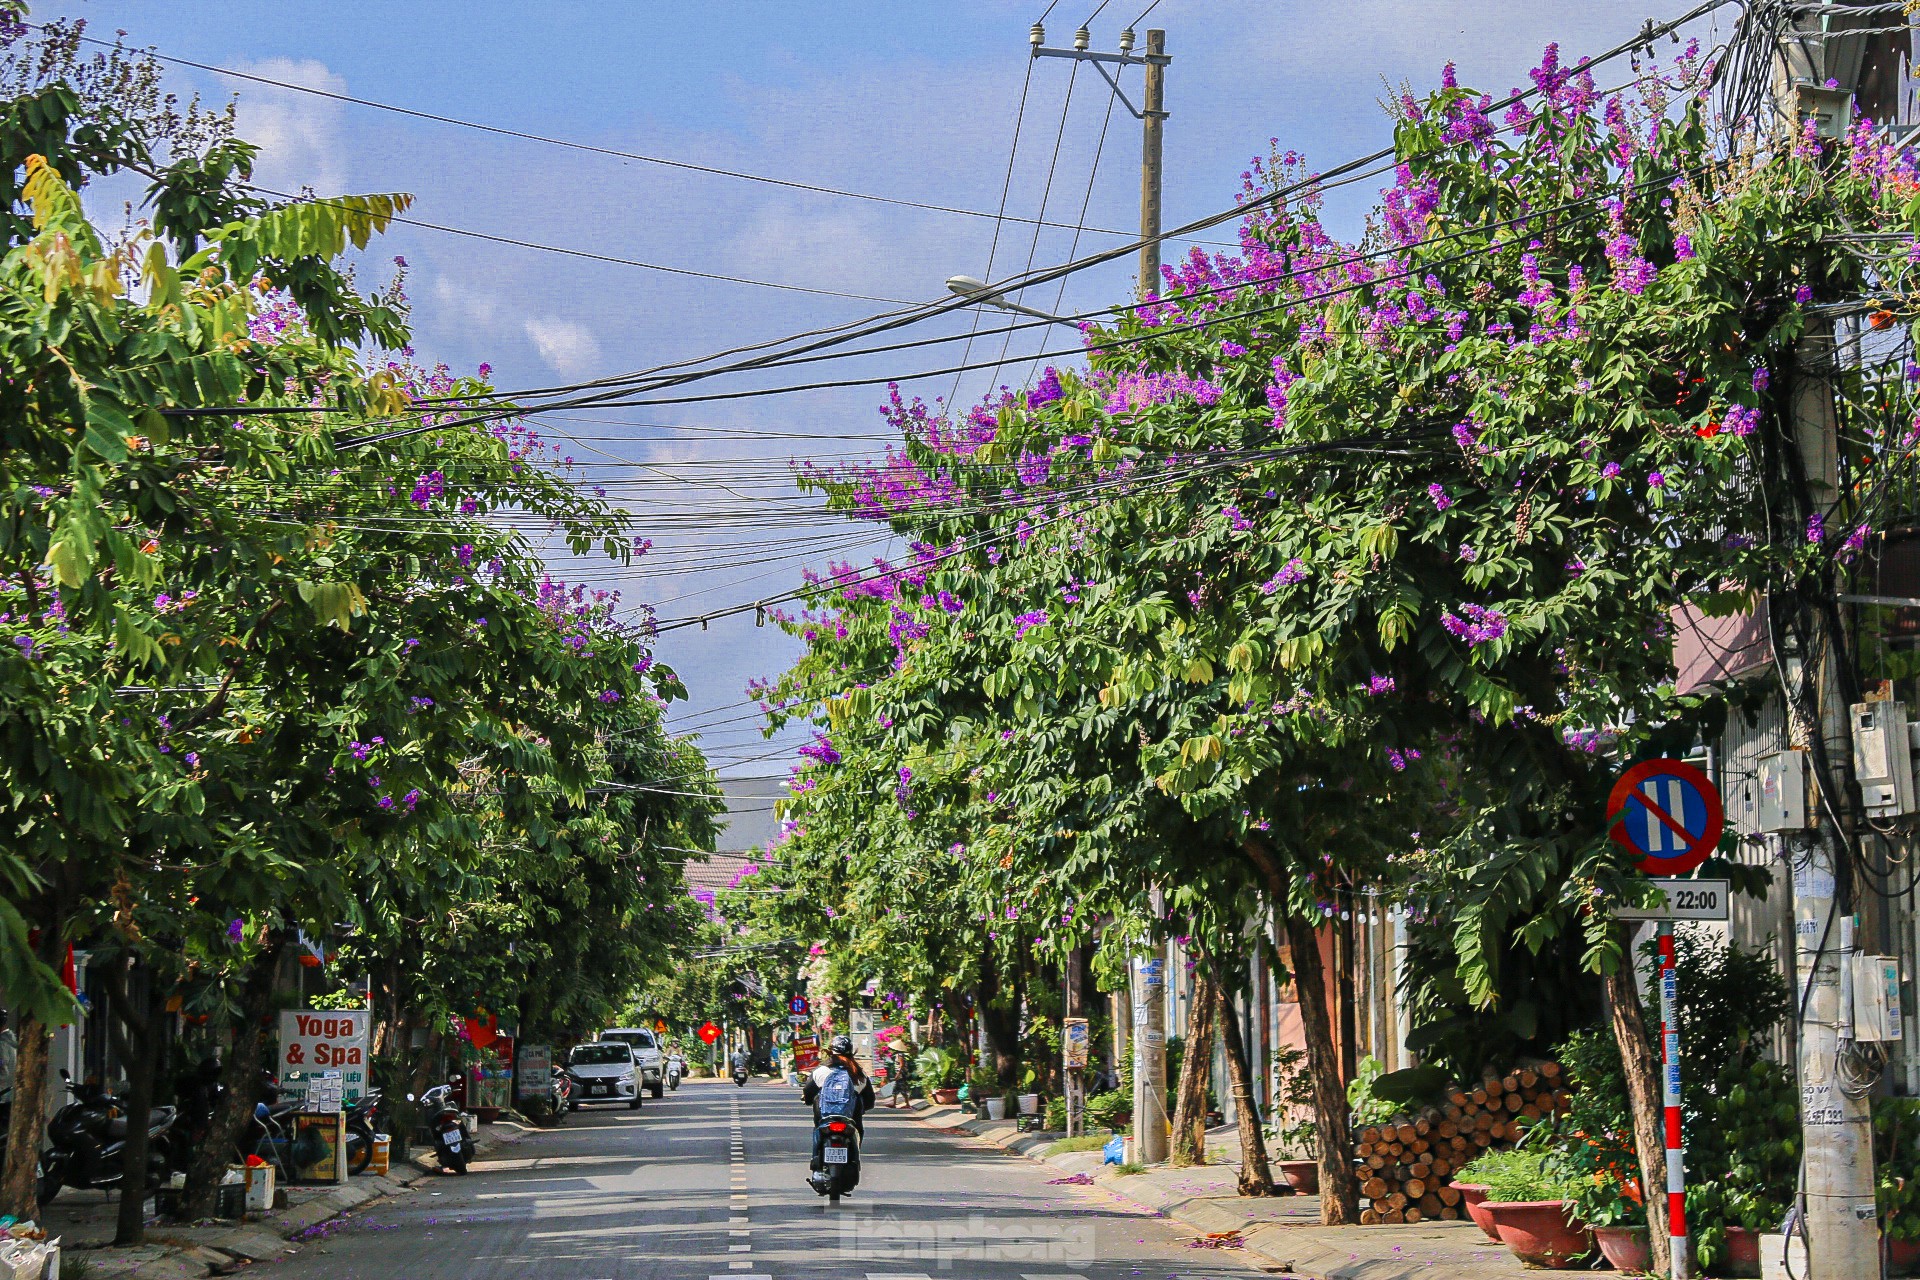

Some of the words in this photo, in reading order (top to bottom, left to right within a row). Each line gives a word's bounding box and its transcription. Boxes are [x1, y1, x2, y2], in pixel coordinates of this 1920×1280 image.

[1676, 890, 1717, 909] 22:00
[295, 1014, 354, 1039] Yoga
[286, 1043, 305, 1064] &
[314, 1043, 361, 1067] Spa
